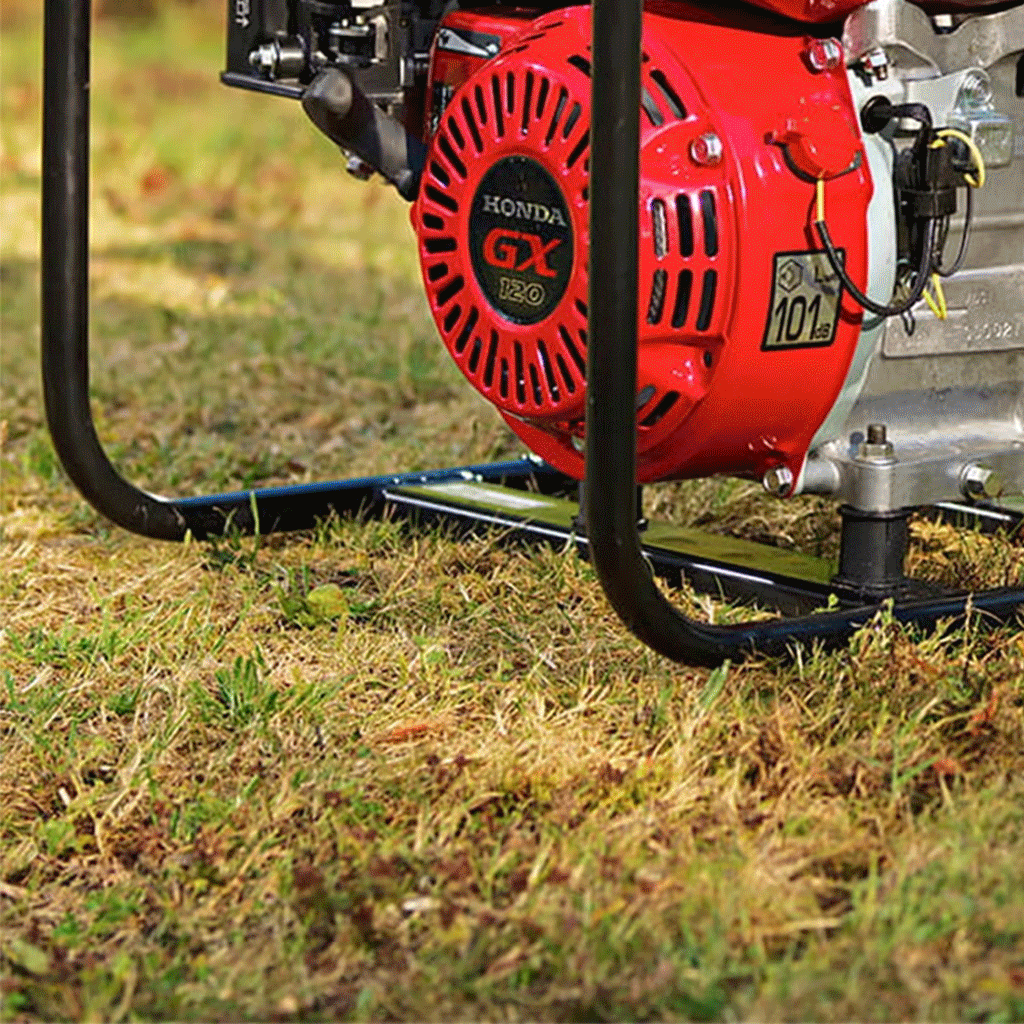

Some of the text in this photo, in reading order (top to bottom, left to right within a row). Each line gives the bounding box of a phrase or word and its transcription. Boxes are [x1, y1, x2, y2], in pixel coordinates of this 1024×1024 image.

[481, 194, 568, 227] HONDA
[482, 227, 562, 278] GX
[499, 276, 546, 306] 120
